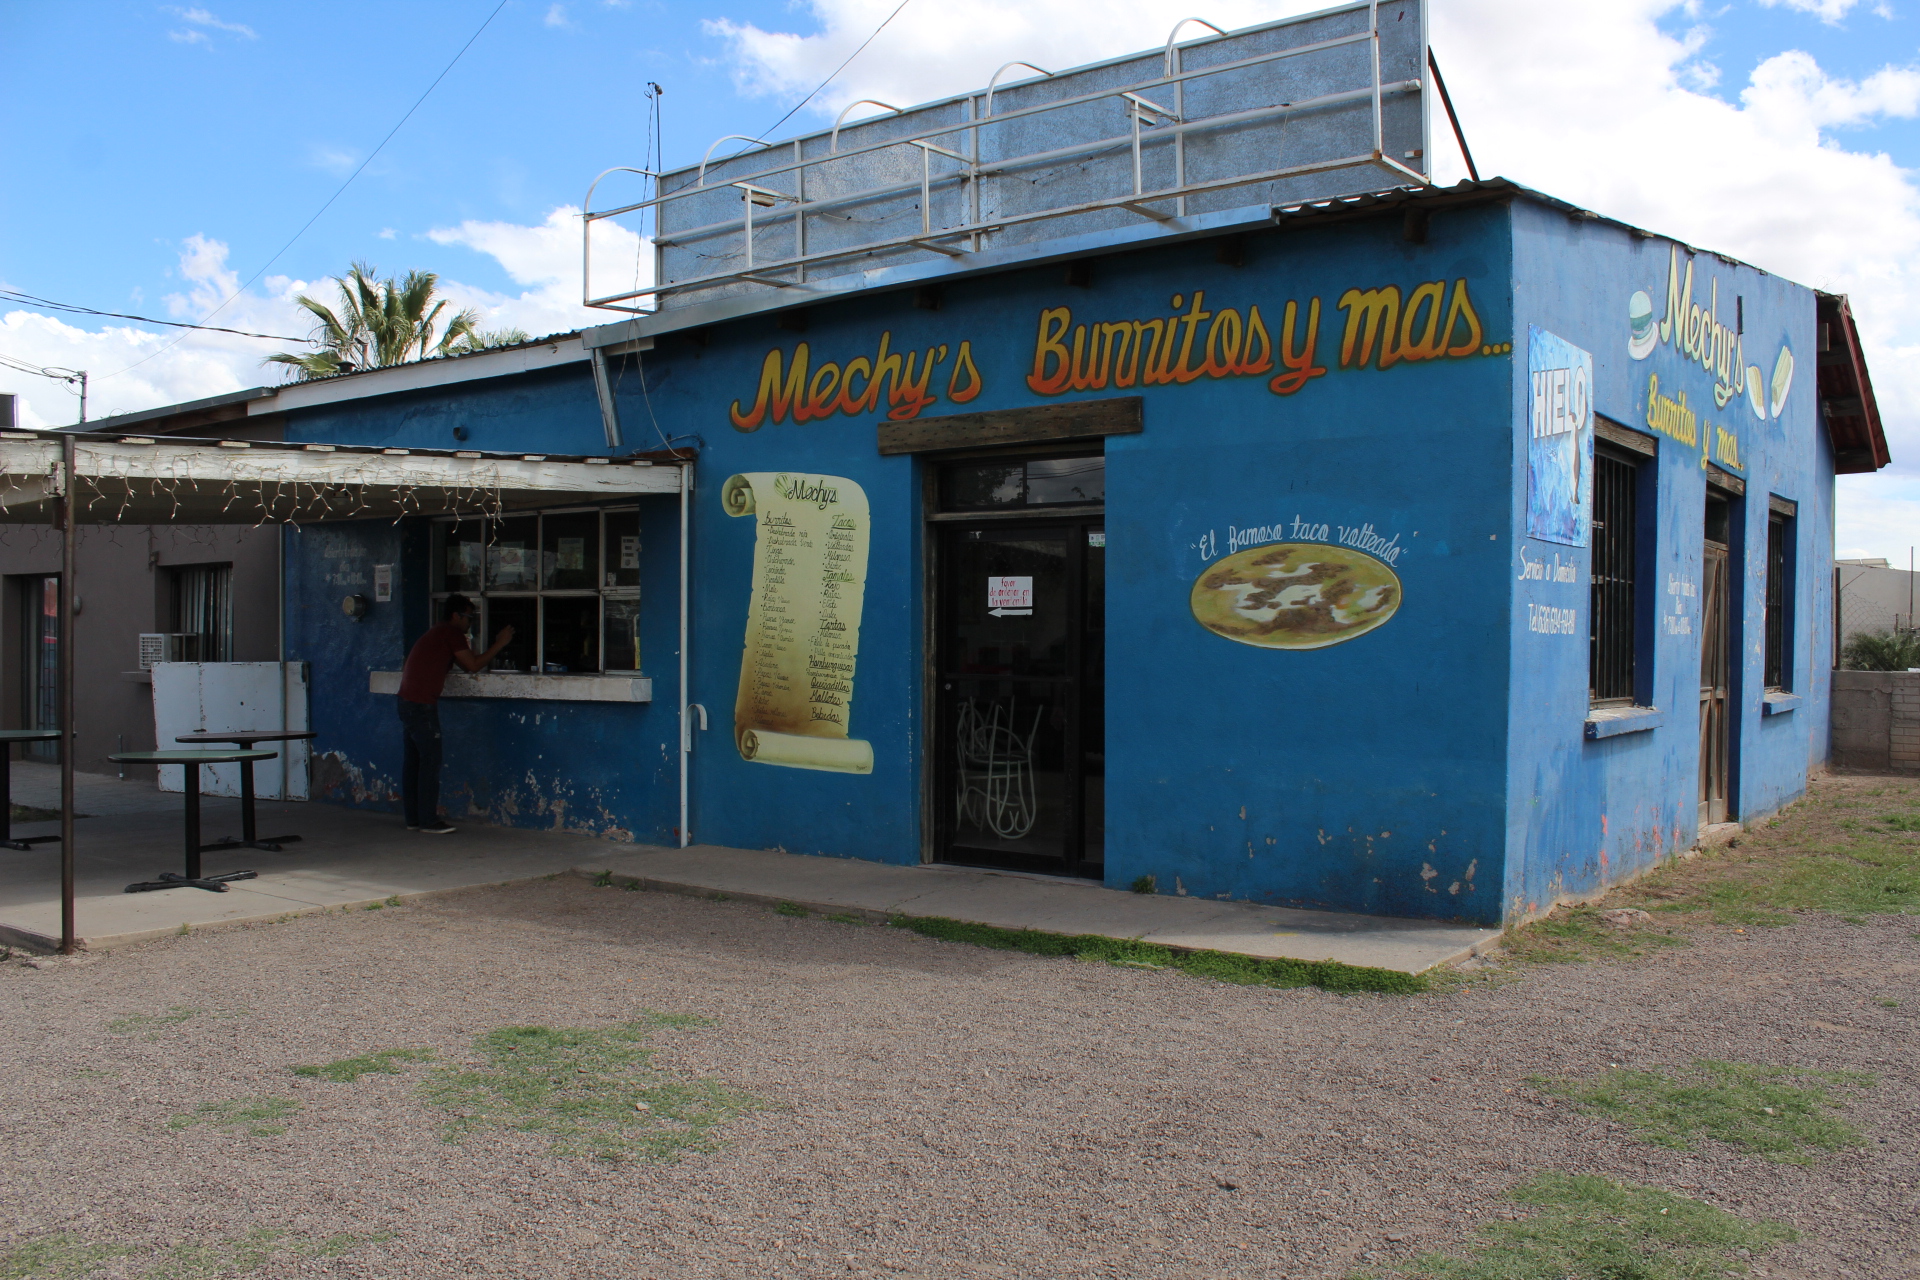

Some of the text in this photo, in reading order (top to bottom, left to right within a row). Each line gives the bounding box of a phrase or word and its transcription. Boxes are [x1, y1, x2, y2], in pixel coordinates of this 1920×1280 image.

[731, 331, 982, 431] Mechy's
[1026, 291, 1274, 394] Burritos
[1270, 297, 1325, 394] y
[1660, 244, 1744, 409] Mechy's
[1533, 366, 1586, 439] HIELO
[1647, 372, 1696, 448] Burritos
[1701, 419, 1711, 470] y
[788, 480, 837, 510] Mechy's
[1290, 514, 1329, 541] taco
